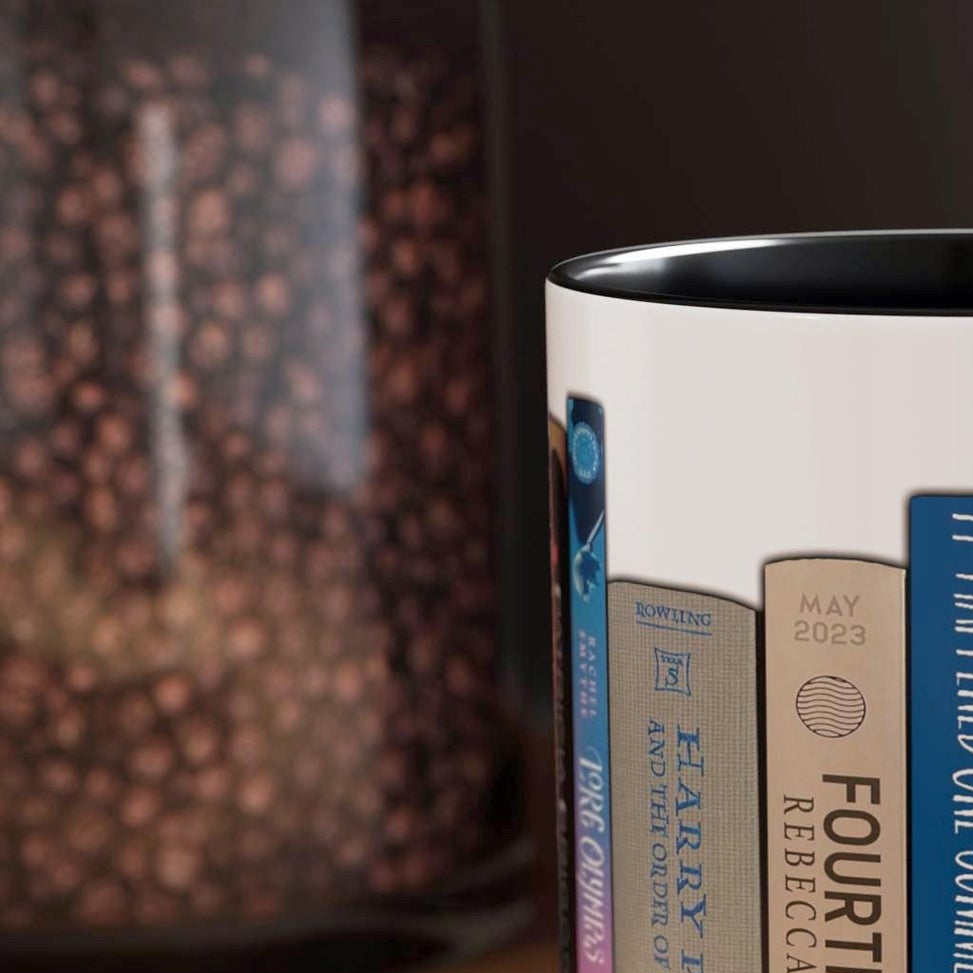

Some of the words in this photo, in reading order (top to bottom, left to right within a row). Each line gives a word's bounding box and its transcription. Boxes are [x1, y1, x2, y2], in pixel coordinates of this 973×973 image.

[636, 601, 712, 627] ROWLING
[799, 593, 860, 617] MAY
[793, 620, 867, 646] 2023
[648, 717, 667, 777] AND
[650, 782, 669, 839] THE
[675, 723, 709, 938] HARRY
[650, 842, 671, 928] ORDER
[653, 935, 672, 970] OF
